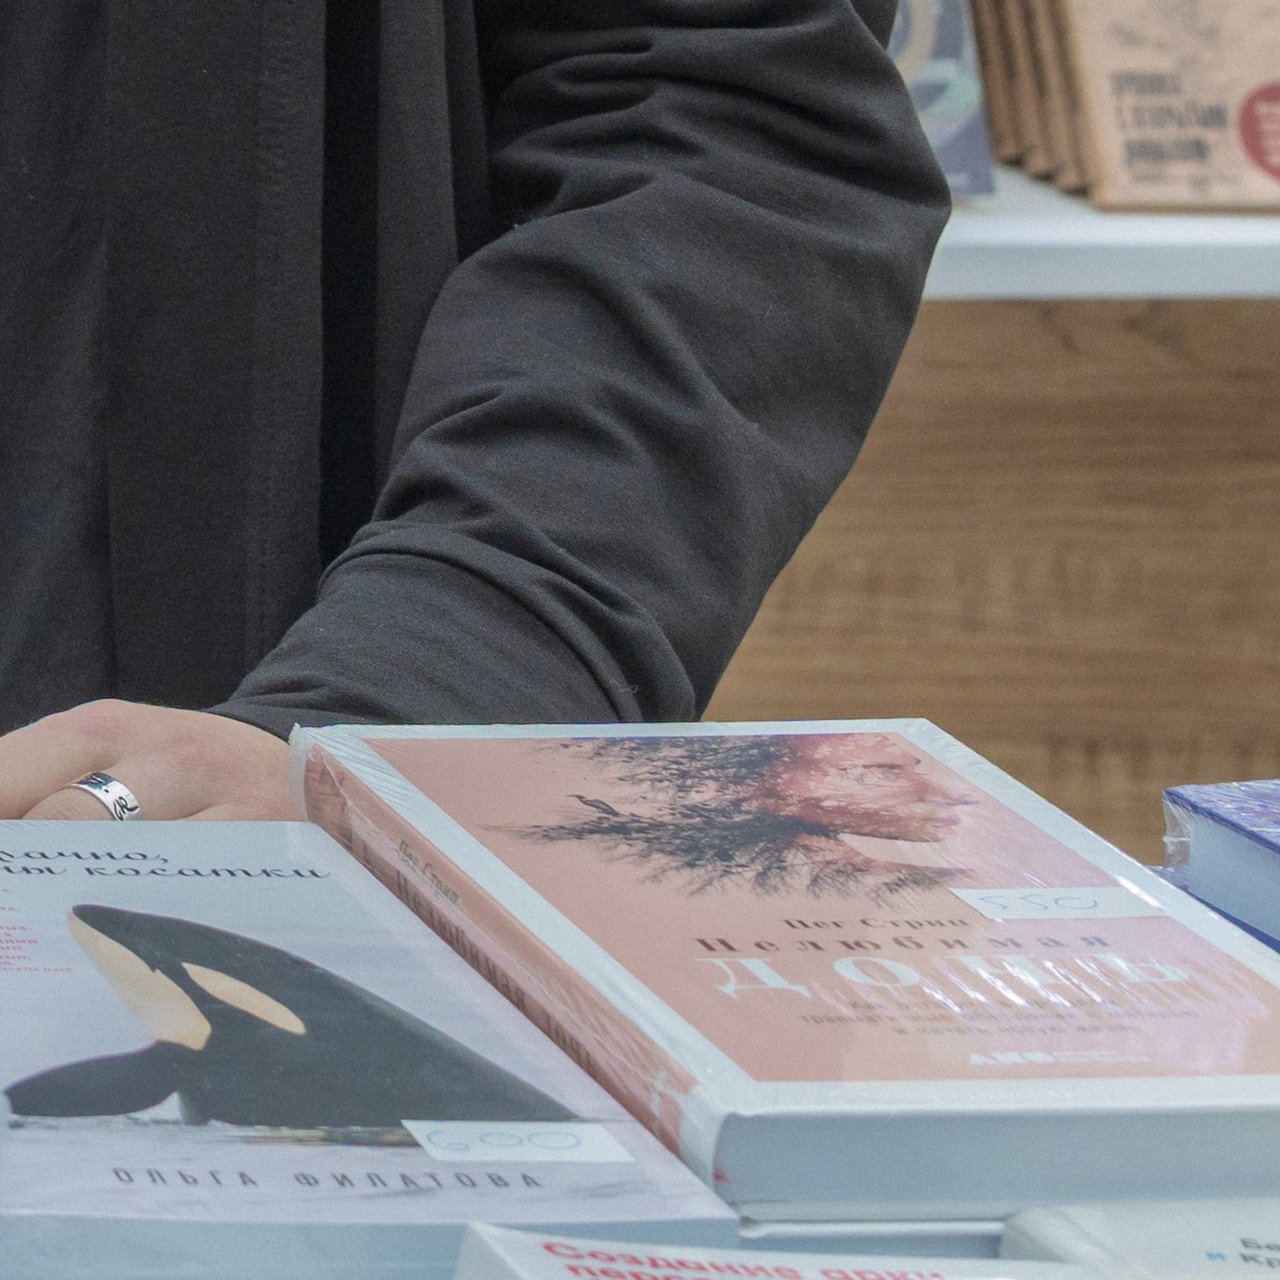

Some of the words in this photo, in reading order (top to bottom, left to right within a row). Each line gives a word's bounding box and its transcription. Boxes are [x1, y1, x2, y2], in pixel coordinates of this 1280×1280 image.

[84, 866, 332, 880] косатки
[978, 893, 1098, 910] 550
[782, 919, 845, 929] Пег
[859, 917, 970, 930] Стрип
[694, 936, 1111, 952] Нелюбимая
[426, 1129, 581, 1151] 600
[112, 1166, 258, 1187] ОЛЬГА
[294, 1170, 544, 1189] ФИЛАТОВА
[541, 1241, 802, 1280] Создание
